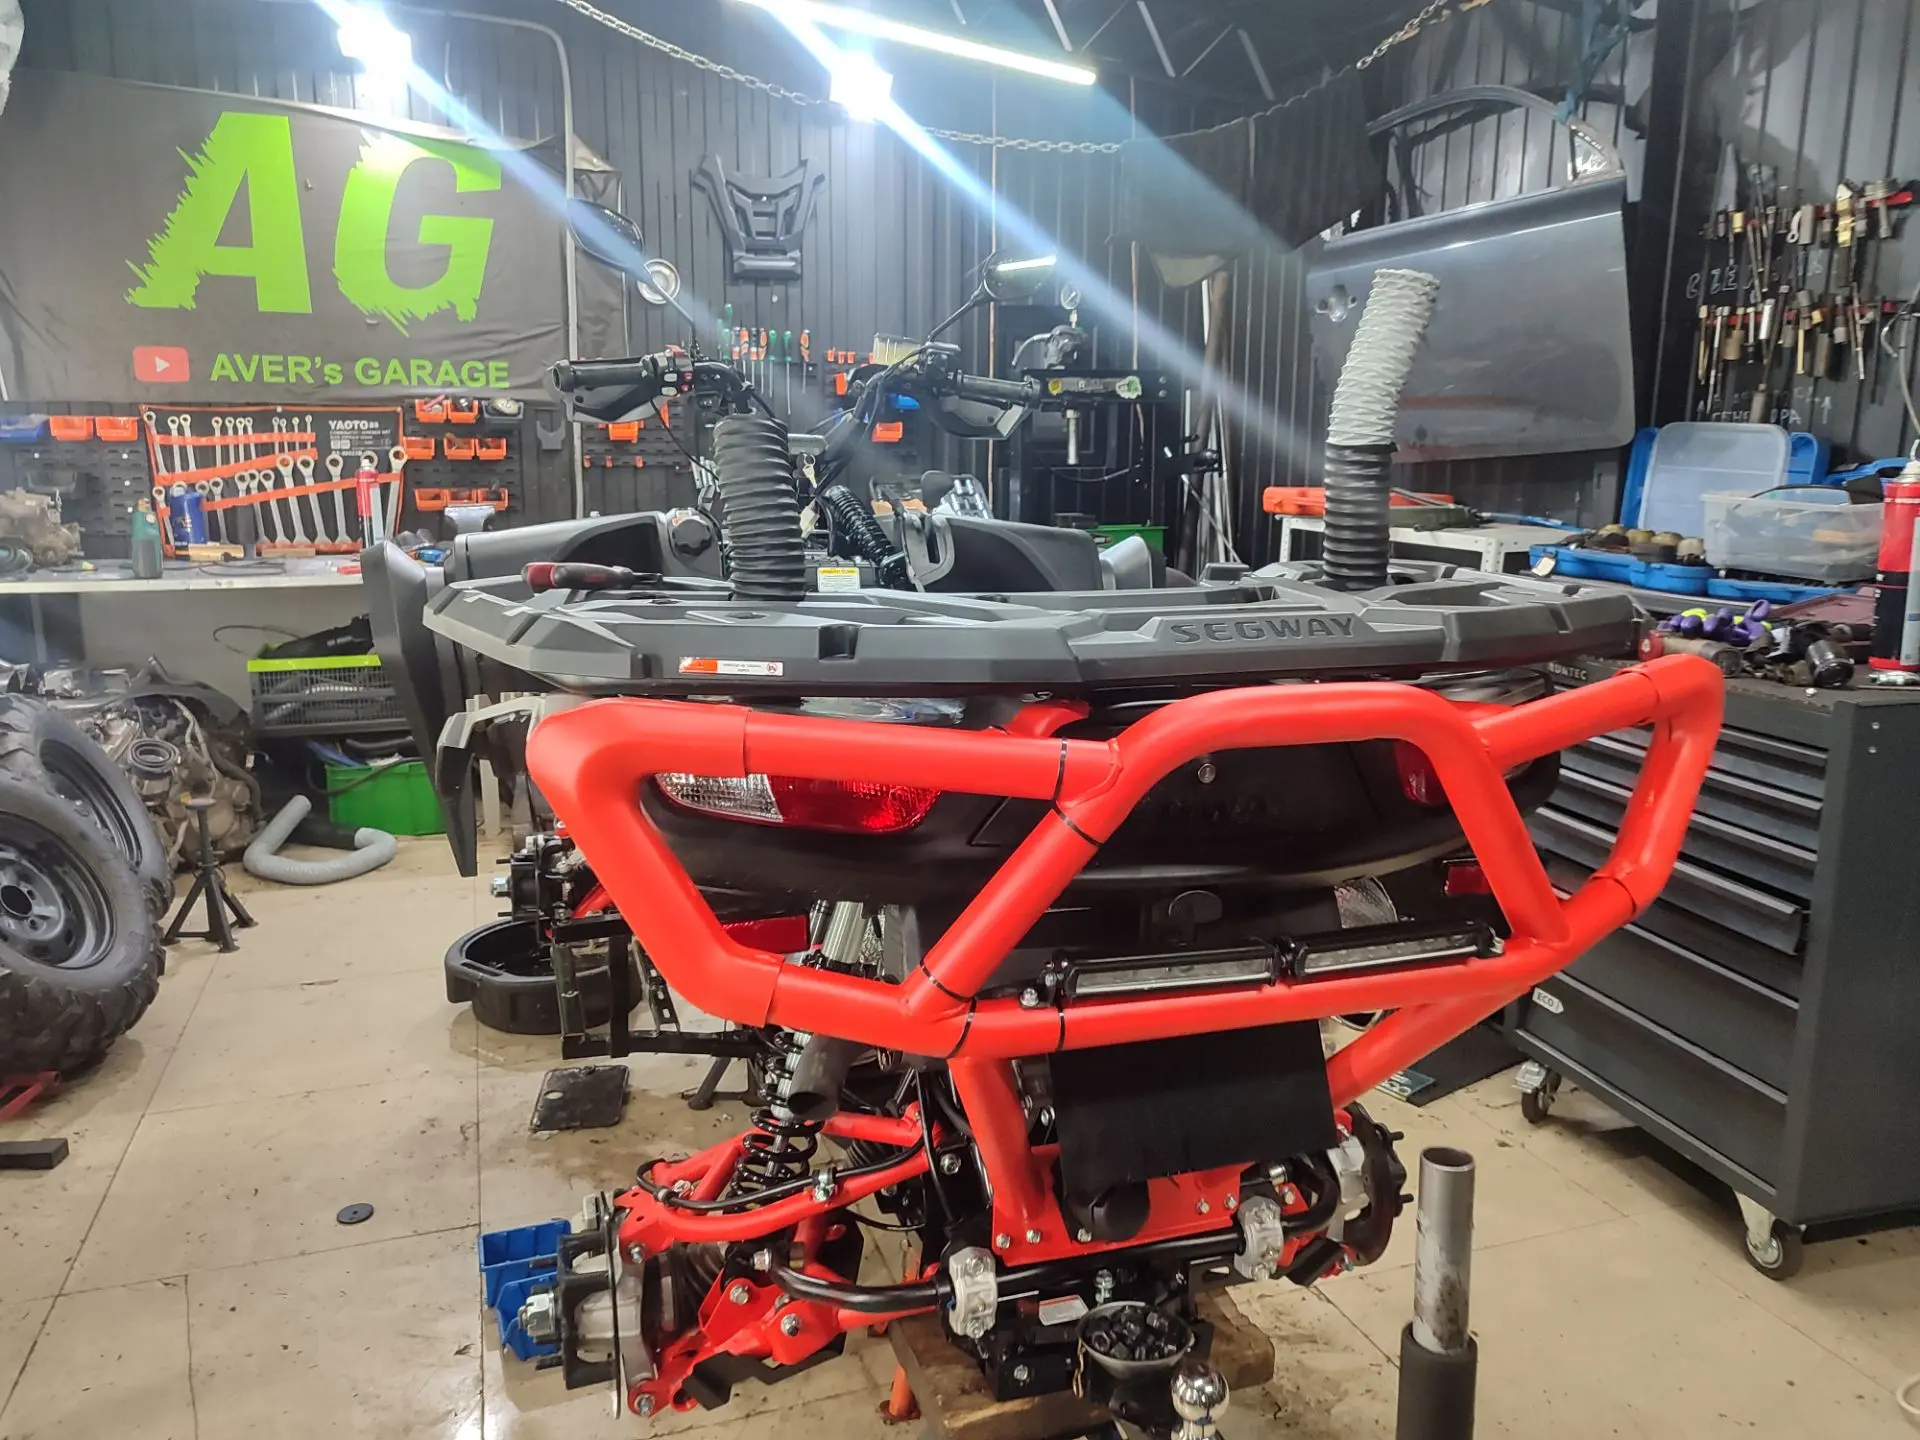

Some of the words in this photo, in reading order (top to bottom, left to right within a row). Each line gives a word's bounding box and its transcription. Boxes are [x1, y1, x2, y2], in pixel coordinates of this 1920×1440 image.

[123, 111, 501, 337] AG
[210, 353, 343, 384] AVER's
[354, 357, 510, 388] GARAGE
[328, 420, 368, 430] YAOTO
[1171, 618, 1354, 643] SEGWAY
